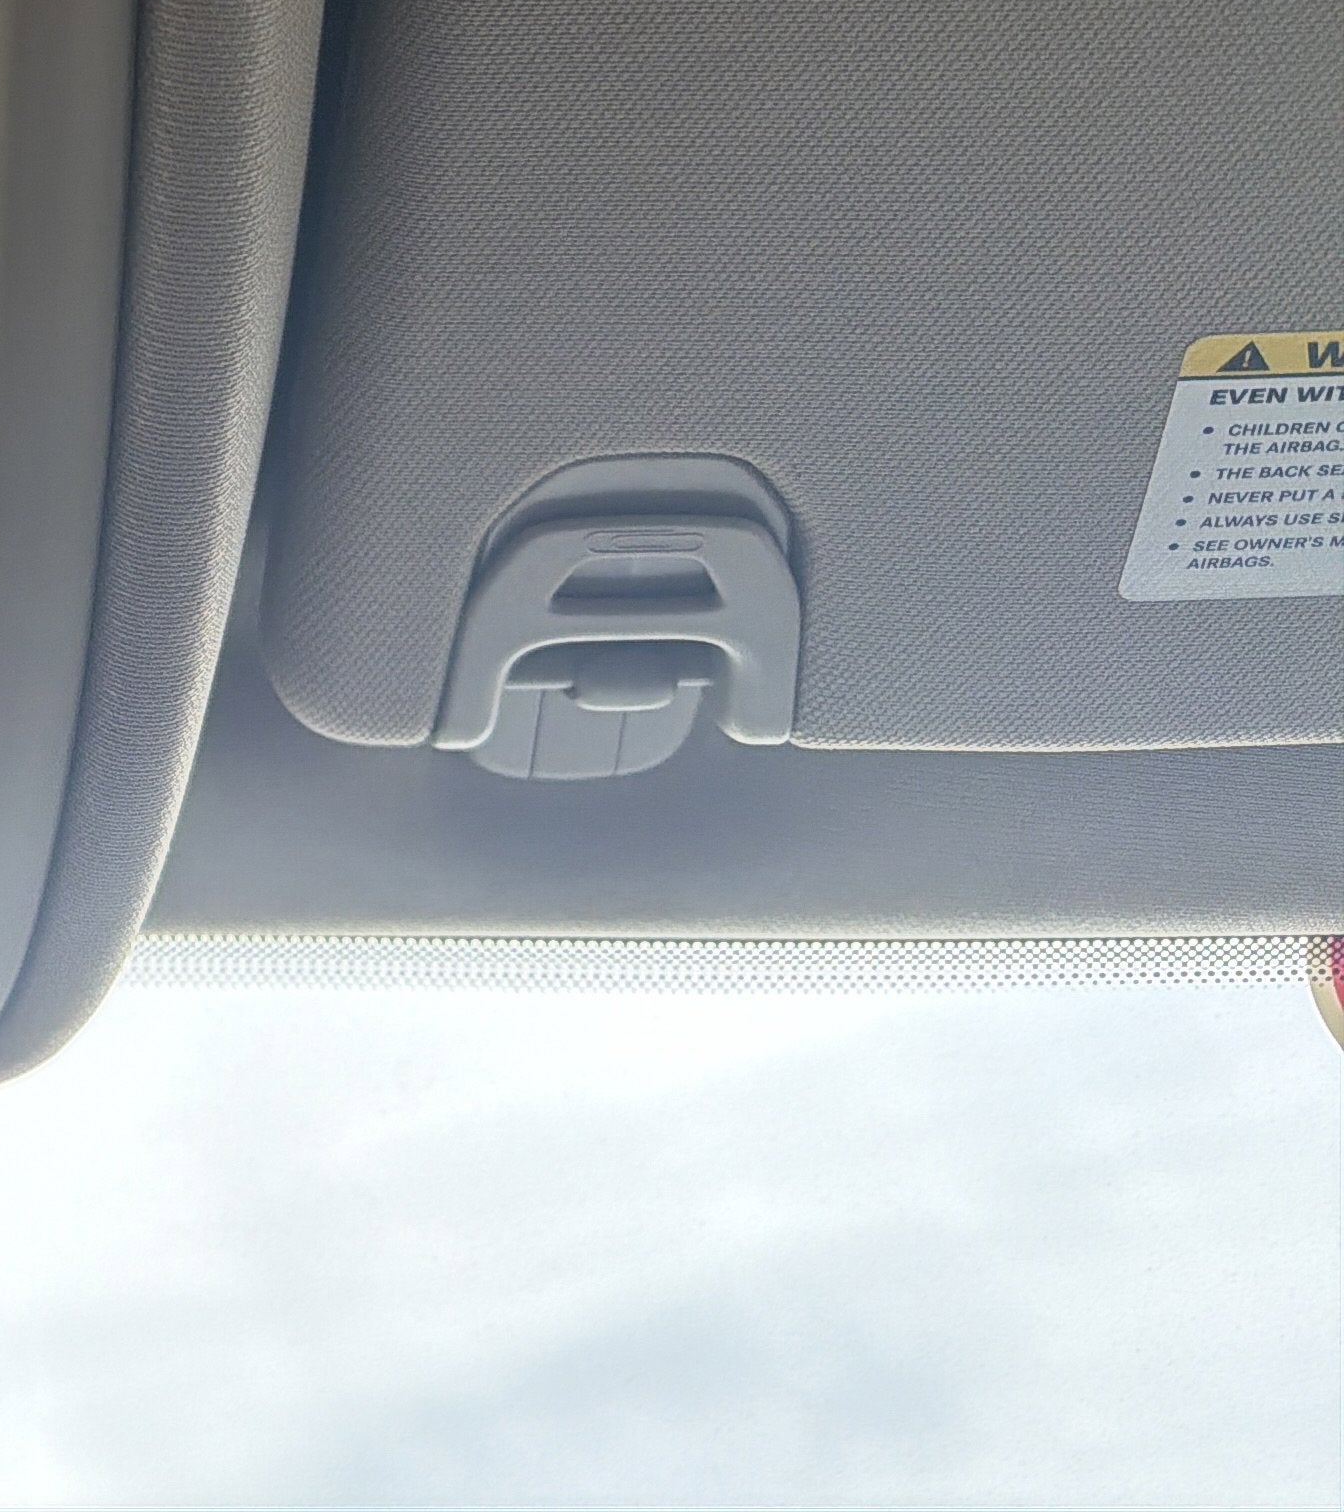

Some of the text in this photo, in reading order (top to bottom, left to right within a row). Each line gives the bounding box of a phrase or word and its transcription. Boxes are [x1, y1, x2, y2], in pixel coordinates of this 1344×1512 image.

[1209, 387, 1288, 406] EVEN
[1228, 421, 1330, 437] CHILDREN
[1224, 443, 1261, 455] THE
[1216, 467, 1254, 479] THE
[1258, 464, 1311, 478] BACK
[1208, 490, 1272, 504] NEVER
[1278, 489, 1318, 502] PUT
[1322, 488, 1336, 500] A
[1199, 514, 1278, 529] ALWAYS
[1284, 512, 1322, 525] USE
[1192, 539, 1229, 552] SEE
[1234, 536, 1324, 550] OWNER'S
[1186, 555, 1275, 570] AIRBAGS.
